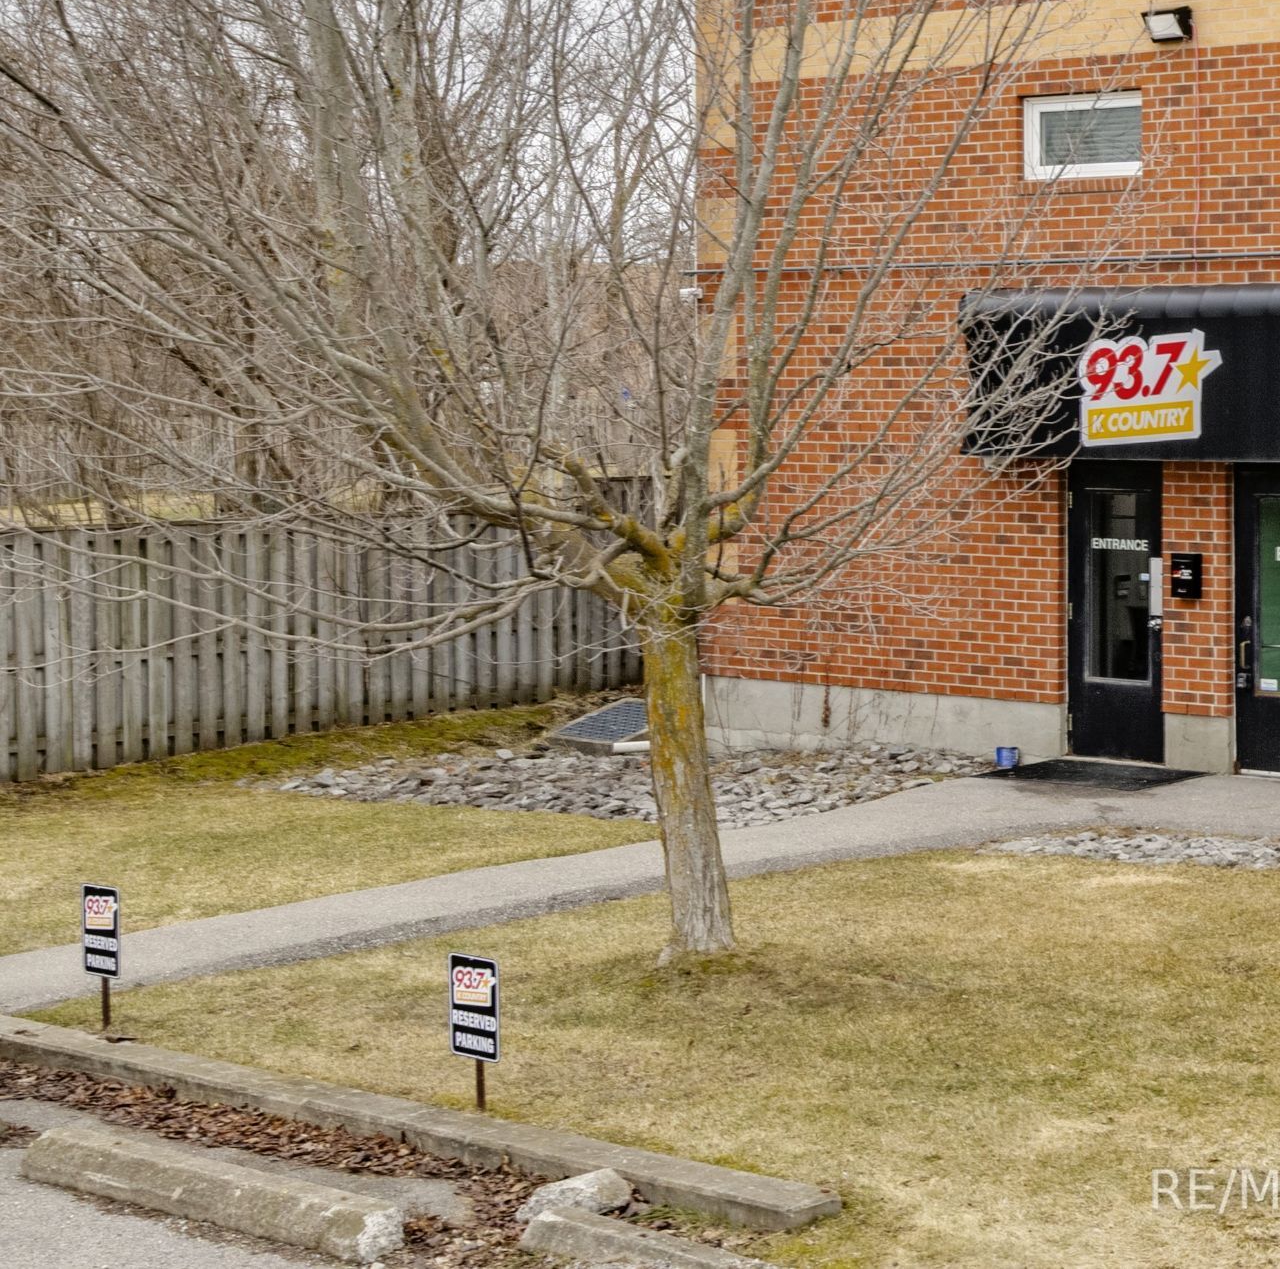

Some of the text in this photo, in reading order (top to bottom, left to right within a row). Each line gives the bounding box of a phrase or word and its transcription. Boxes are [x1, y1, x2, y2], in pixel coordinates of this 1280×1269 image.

[1086, 340, 1188, 401] 93.7
[1091, 406, 1191, 434] K COUNTRY
[1091, 537, 1150, 551] ENTRANCE
[86, 897, 111, 916] 93.7
[85, 933, 118, 952] RESERVED
[87, 953, 117, 972] PARKING
[454, 969, 486, 990] 93.7
[452, 1008, 497, 1032] RESERVED
[455, 1031, 495, 1053] PARKING
